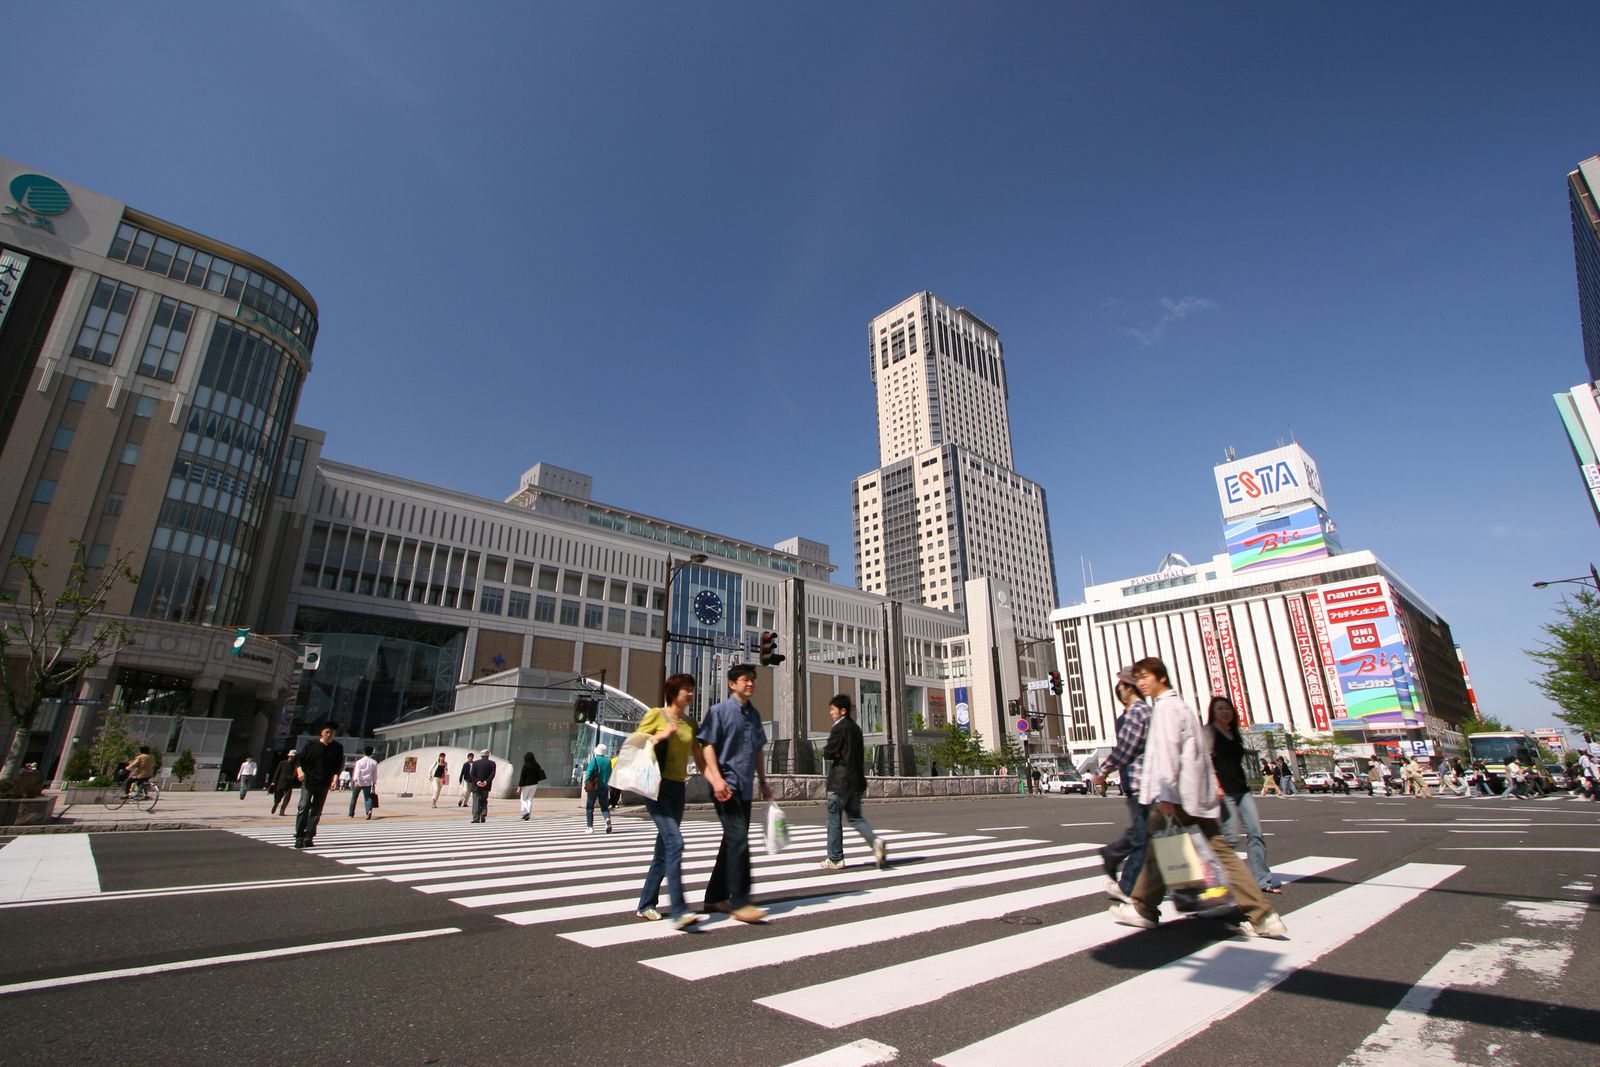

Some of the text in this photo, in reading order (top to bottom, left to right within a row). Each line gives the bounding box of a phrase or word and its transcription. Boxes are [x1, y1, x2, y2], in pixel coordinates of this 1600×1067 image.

[1, 205, 56, 235] 大丸
[1224, 461, 1298, 504] ESTA
[1243, 530, 1300, 555] Bic
[1131, 569, 1187, 585] PLANIS HALL
[1326, 586, 1377, 600] namco
[1330, 605, 1386, 619] アカチャンホンポ
[1351, 628, 1372, 637] UNI
[1353, 635, 1375, 645] QLO
[1413, 740, 1424, 751] P
